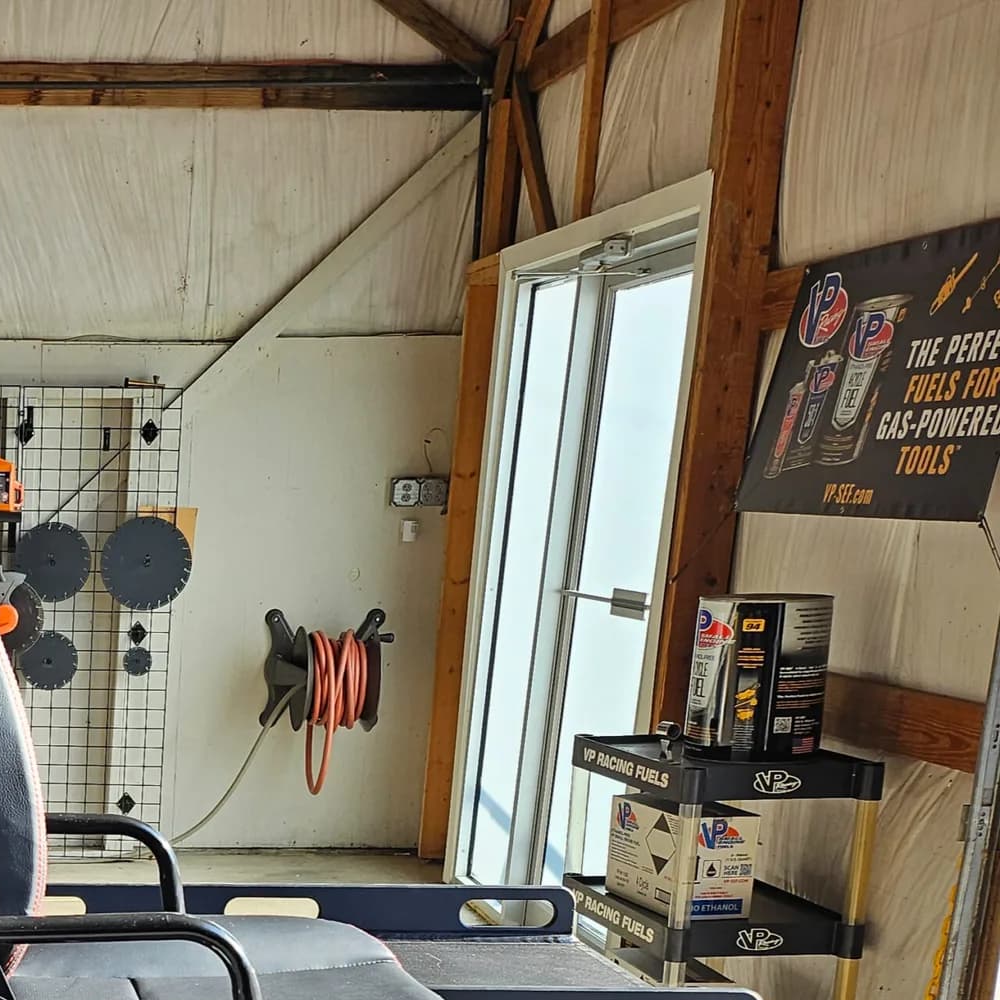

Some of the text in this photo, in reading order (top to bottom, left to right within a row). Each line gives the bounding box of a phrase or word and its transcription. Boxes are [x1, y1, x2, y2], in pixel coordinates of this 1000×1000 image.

[805, 272, 842, 346] VP
[906, 337, 944, 369] THE
[903, 370, 961, 404] FUELS
[962, 366, 1000, 400] FOR
[583, 747, 669, 788] VP RACING FUELS
[701, 818, 728, 849] VP
[584, 896, 620, 925] RACING
[621, 915, 655, 943] FUELS
[701, 904, 739, 912] ETHANOL
